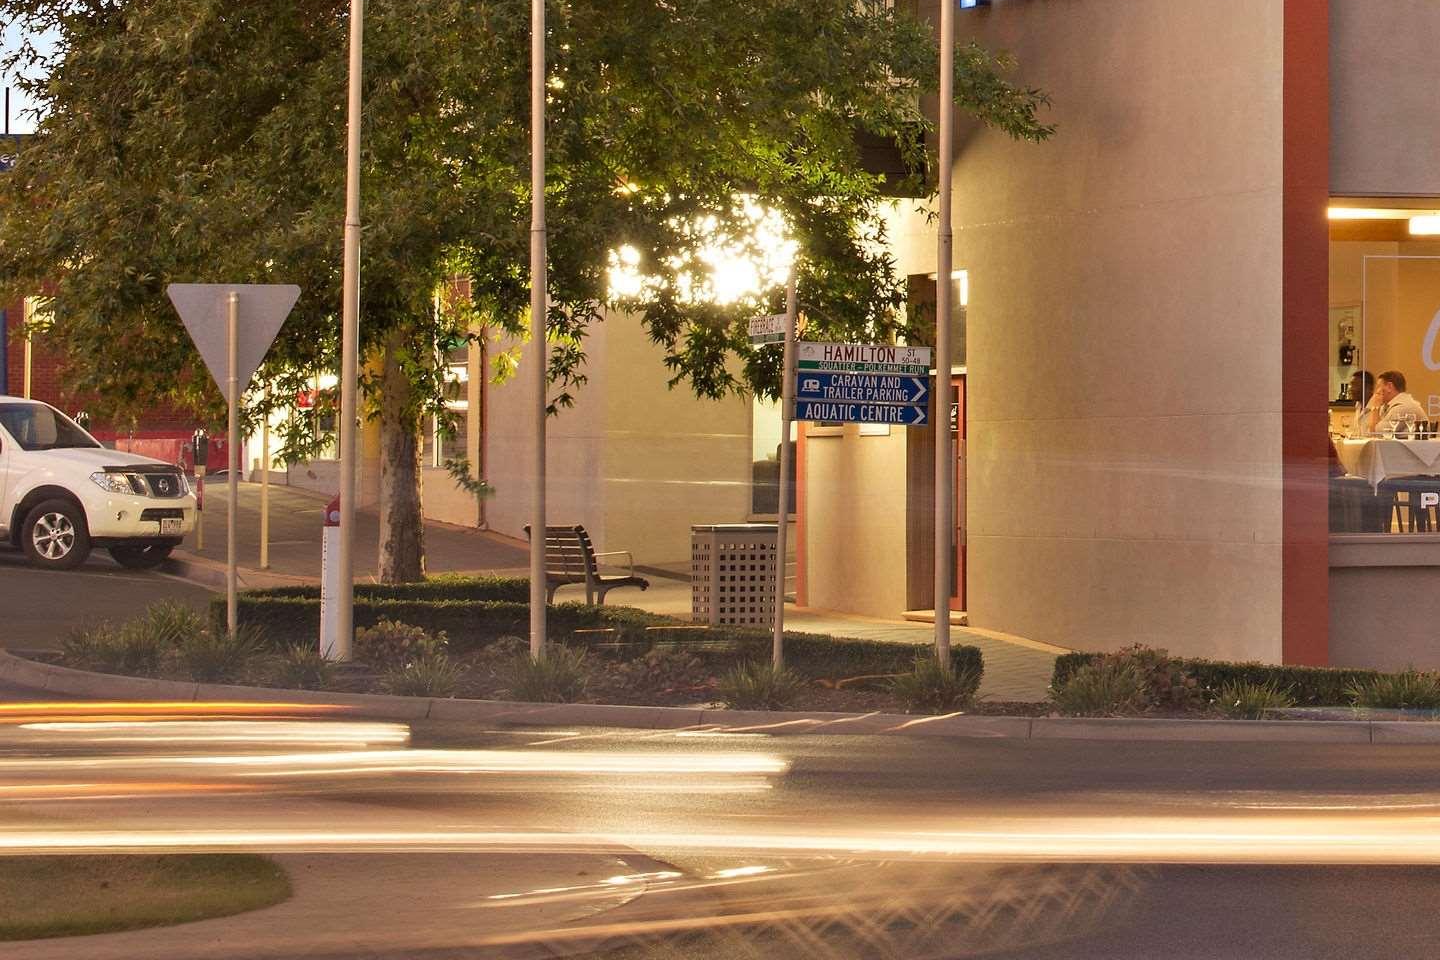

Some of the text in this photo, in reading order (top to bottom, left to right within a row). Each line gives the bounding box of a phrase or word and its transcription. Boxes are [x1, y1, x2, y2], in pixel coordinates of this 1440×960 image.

[824, 345, 896, 363] HAMILTON
[909, 365, 925, 374] RUN
[831, 374, 901, 389] CARAVAN AND
[823, 386, 909, 401] TRAILER PARKING
[805, 403, 904, 422] AQUATIC CENTRE
